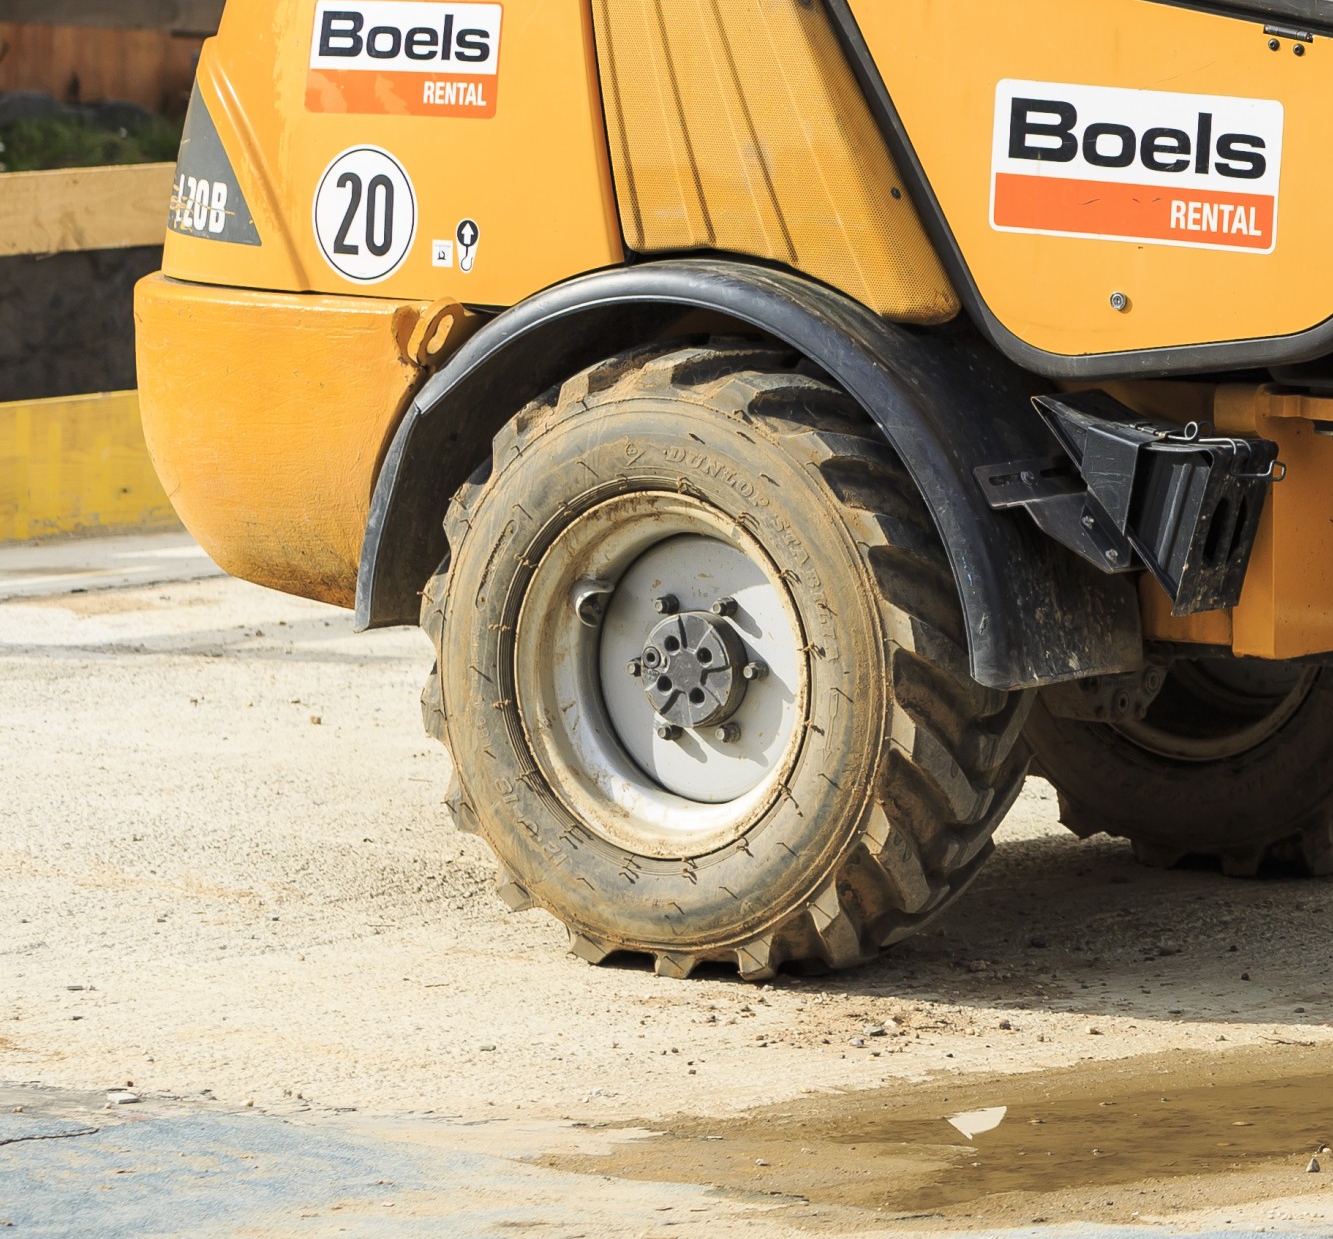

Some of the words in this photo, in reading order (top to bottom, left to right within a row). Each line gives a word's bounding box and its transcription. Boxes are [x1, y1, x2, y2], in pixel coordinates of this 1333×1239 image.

[318, 11, 490, 63] Boels
[423, 81, 487, 107] RENTAL
[1007, 97, 1266, 179] Boels
[333, 172, 394, 257] 20
[1170, 199, 1263, 236] RENTAL
[666, 445, 769, 508] DUNLOP
